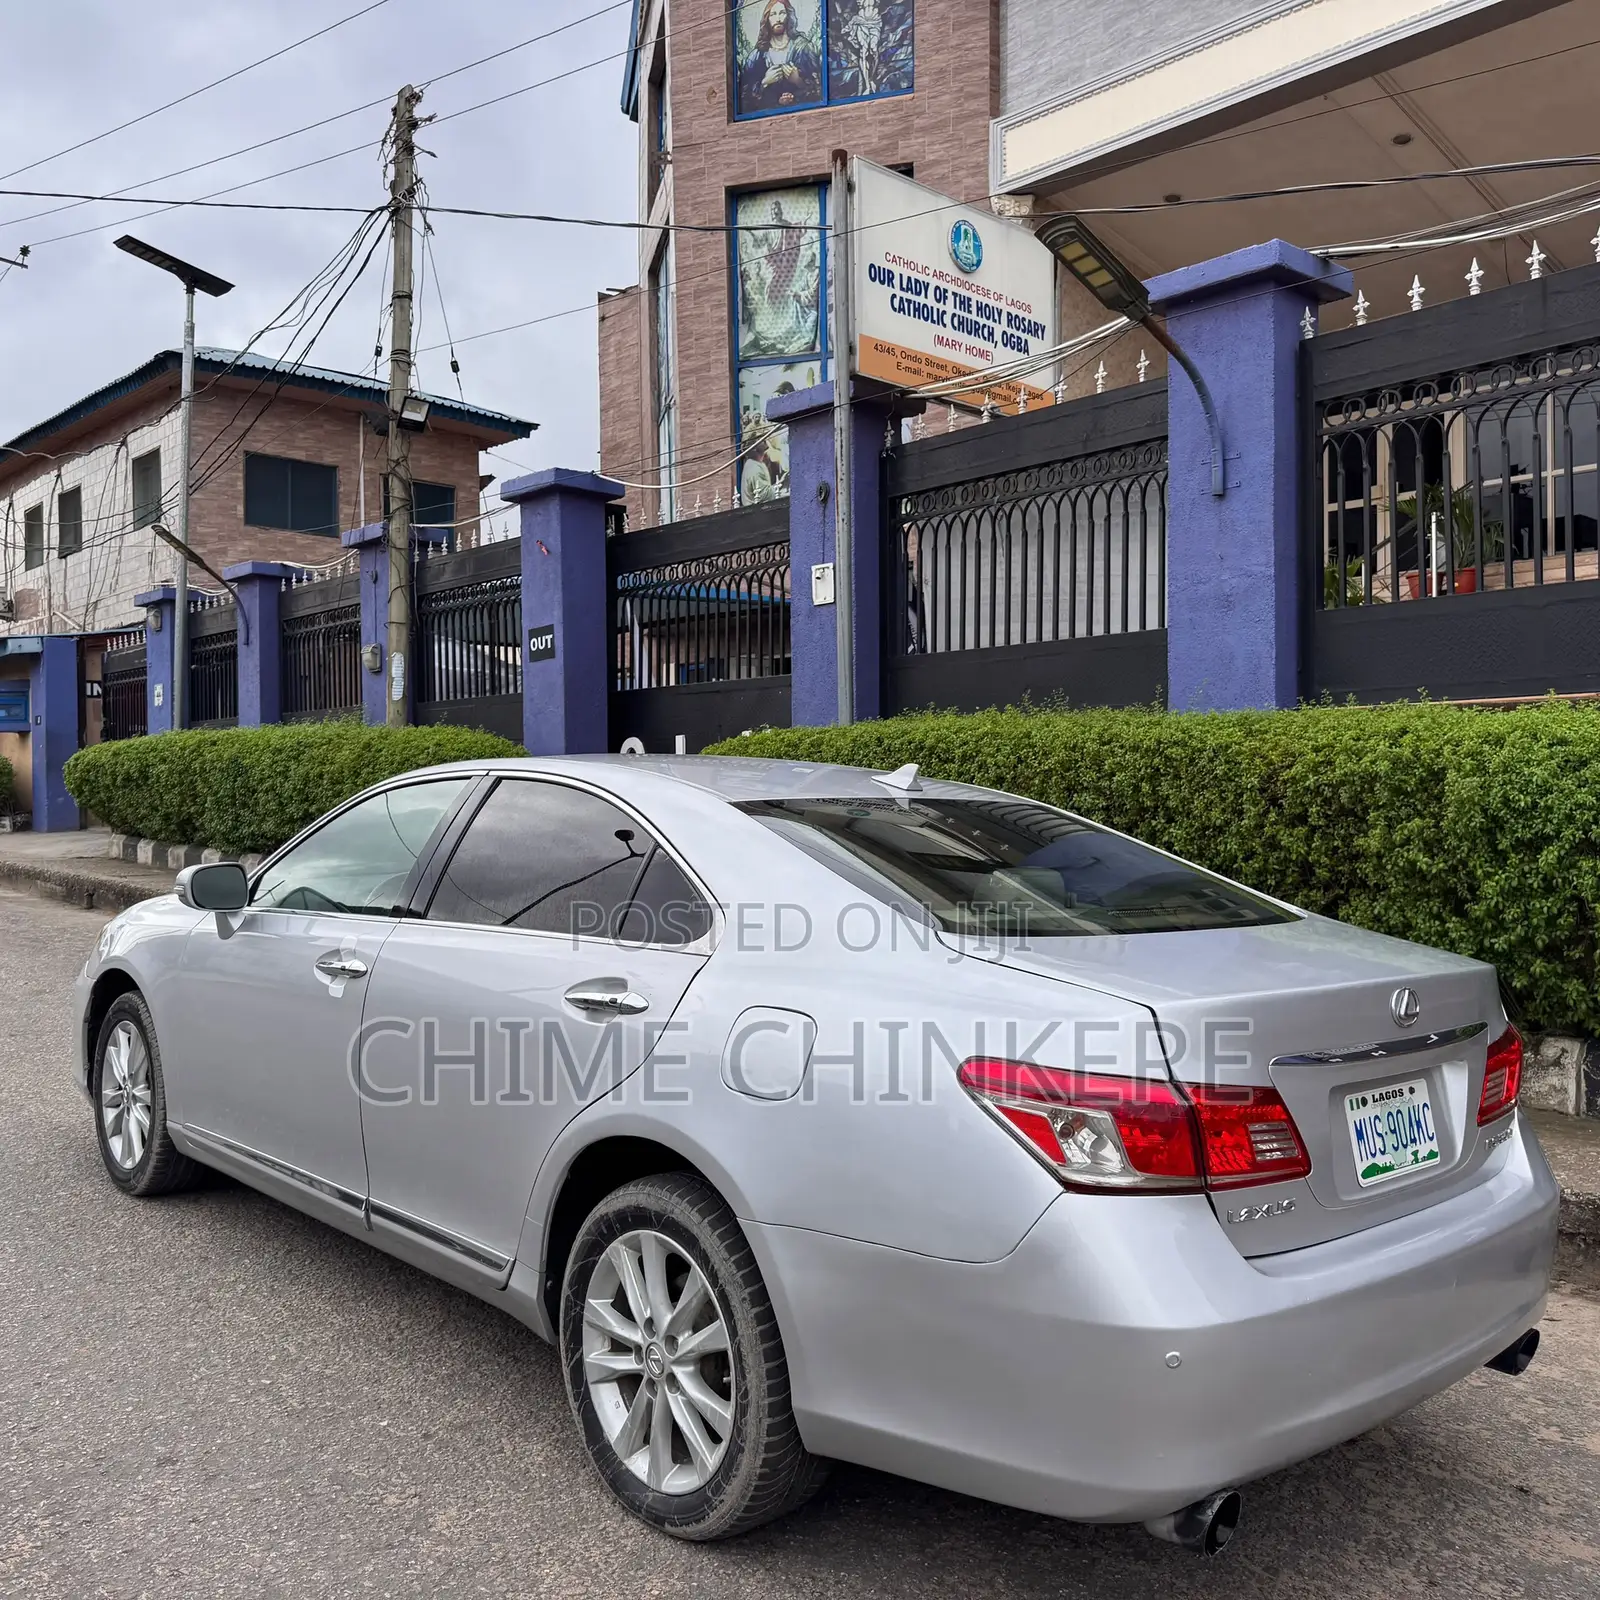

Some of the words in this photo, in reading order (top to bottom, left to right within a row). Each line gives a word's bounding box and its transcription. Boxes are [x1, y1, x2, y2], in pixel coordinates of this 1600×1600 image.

[884, 251, 931, 277] CATHOLIC
[932, 268, 992, 300] ARCHDIOCESE
[993, 291, 1004, 303] OF
[1005, 296, 1032, 314] LAGOS
[868, 263, 895, 289] OUR
[899, 272, 930, 300] LADY
[934, 285, 949, 306] OF
[951, 291, 973, 315] THE
[976, 300, 1003, 325] HOLY
[1006, 311, 1046, 341] ROSARY
[890, 293, 947, 329] CATHOLIC
[950, 312, 998, 349] CHURCH,
[1001, 330, 1030, 356] OGBA
[873, 342, 899, 359] 43/45,
[900, 350, 923, 365] Ondo
[924, 357, 950, 374] Street,
[933, 334, 963, 352] (MARY
[965, 343, 994, 364] HOME)
[896, 361, 925, 378] E-mail:
[530, 634, 553, 651] OUT
[86, 682, 102, 696] IN
[1371, 1088, 1404, 1104] LAGOS
[1227, 1197, 1296, 1224] LEXUS
